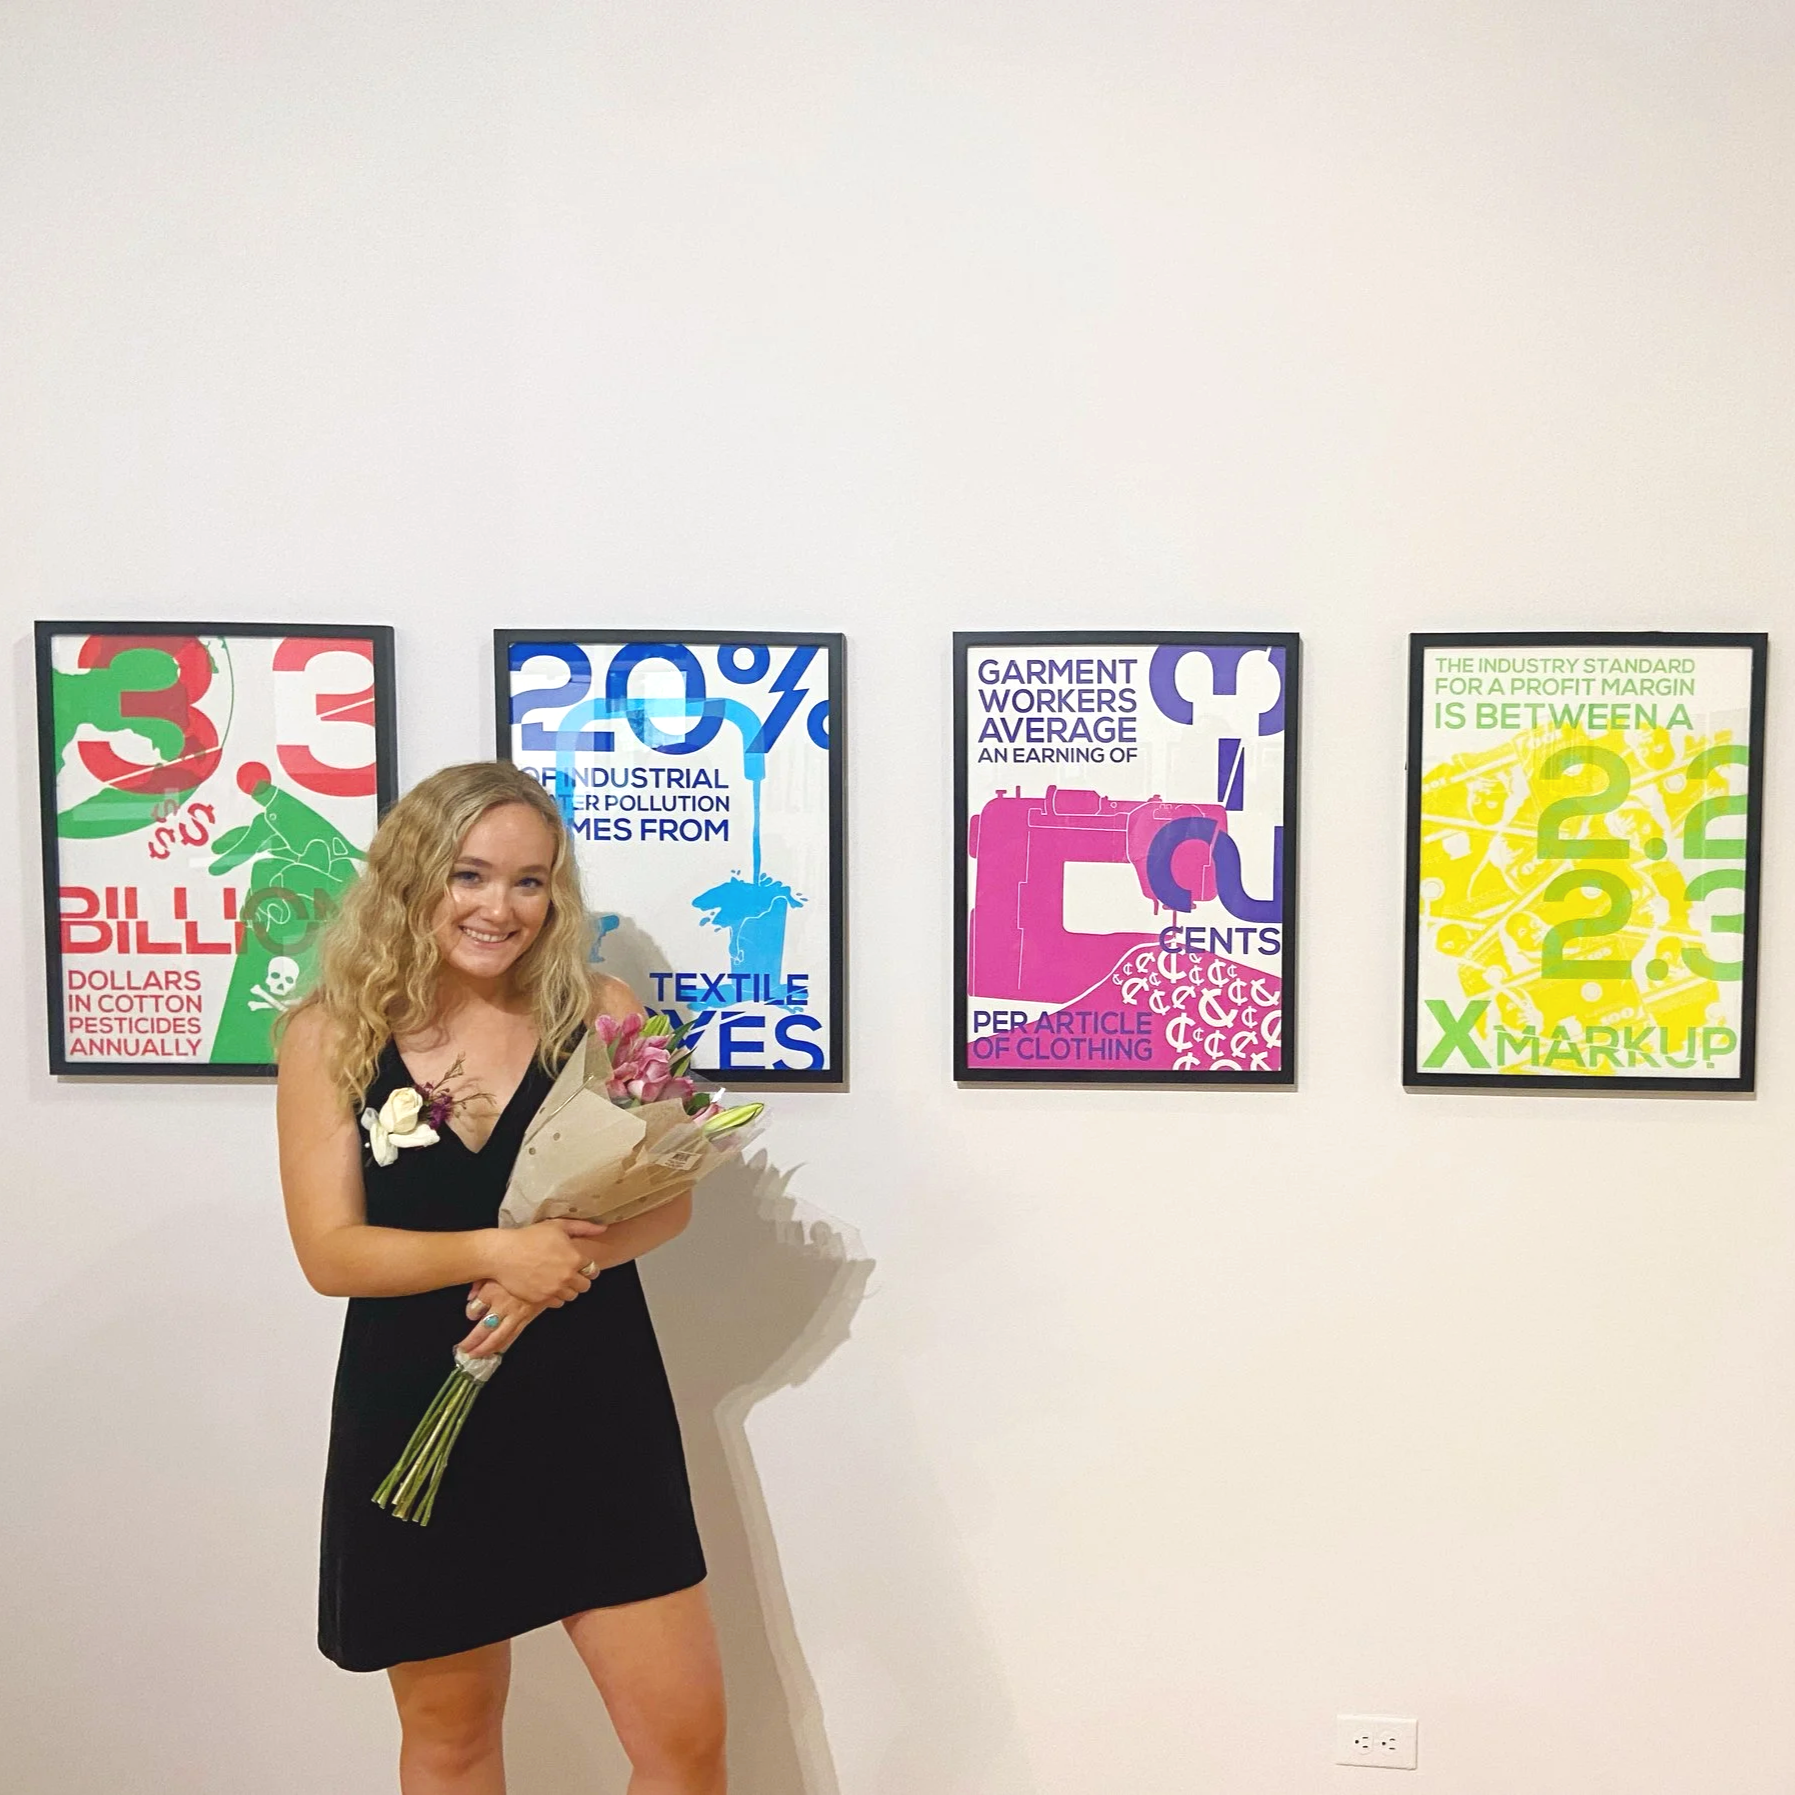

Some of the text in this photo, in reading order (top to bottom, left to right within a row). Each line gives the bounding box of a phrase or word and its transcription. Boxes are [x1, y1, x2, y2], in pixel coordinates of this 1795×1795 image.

[978, 659, 1138, 685] GARMENT
[1435, 658, 1695, 674] THE INDUSTRY STANDARD
[509, 643, 829, 756] 20%
[1435, 678, 1695, 696] FOR A PROFIT MARGIN
[979, 688, 1137, 714] WORKERS
[1435, 702, 1694, 730] IS BETWEEN A
[978, 717, 1137, 744] AVERAGE
[978, 747, 1138, 763] AN EARNING OF
[564, 767, 729, 789] INDUSTRIAL
[604, 795, 730, 812] POLLUTION
[1537, 745, 1748, 860] 2.2
[568, 818, 729, 842] MES FROM
[1541, 868, 1745, 981] 2.3
[1159, 926, 1281, 955] CENTS
[68, 970, 201, 991] DOLLARS
[649, 972, 809, 1006] TEXTILE
[68, 994, 202, 1014] IN COTTON
[69, 1017, 201, 1034] PESTICIDES
[973, 1010, 1152, 1035] PER ARTICLE
[1422, 999, 1737, 1069] X MARKUP
[70, 1038, 202, 1057] ANNUALLY
[644, 1004, 825, 1070] YES
[973, 1036, 1153, 1061] OF CLOTHING
